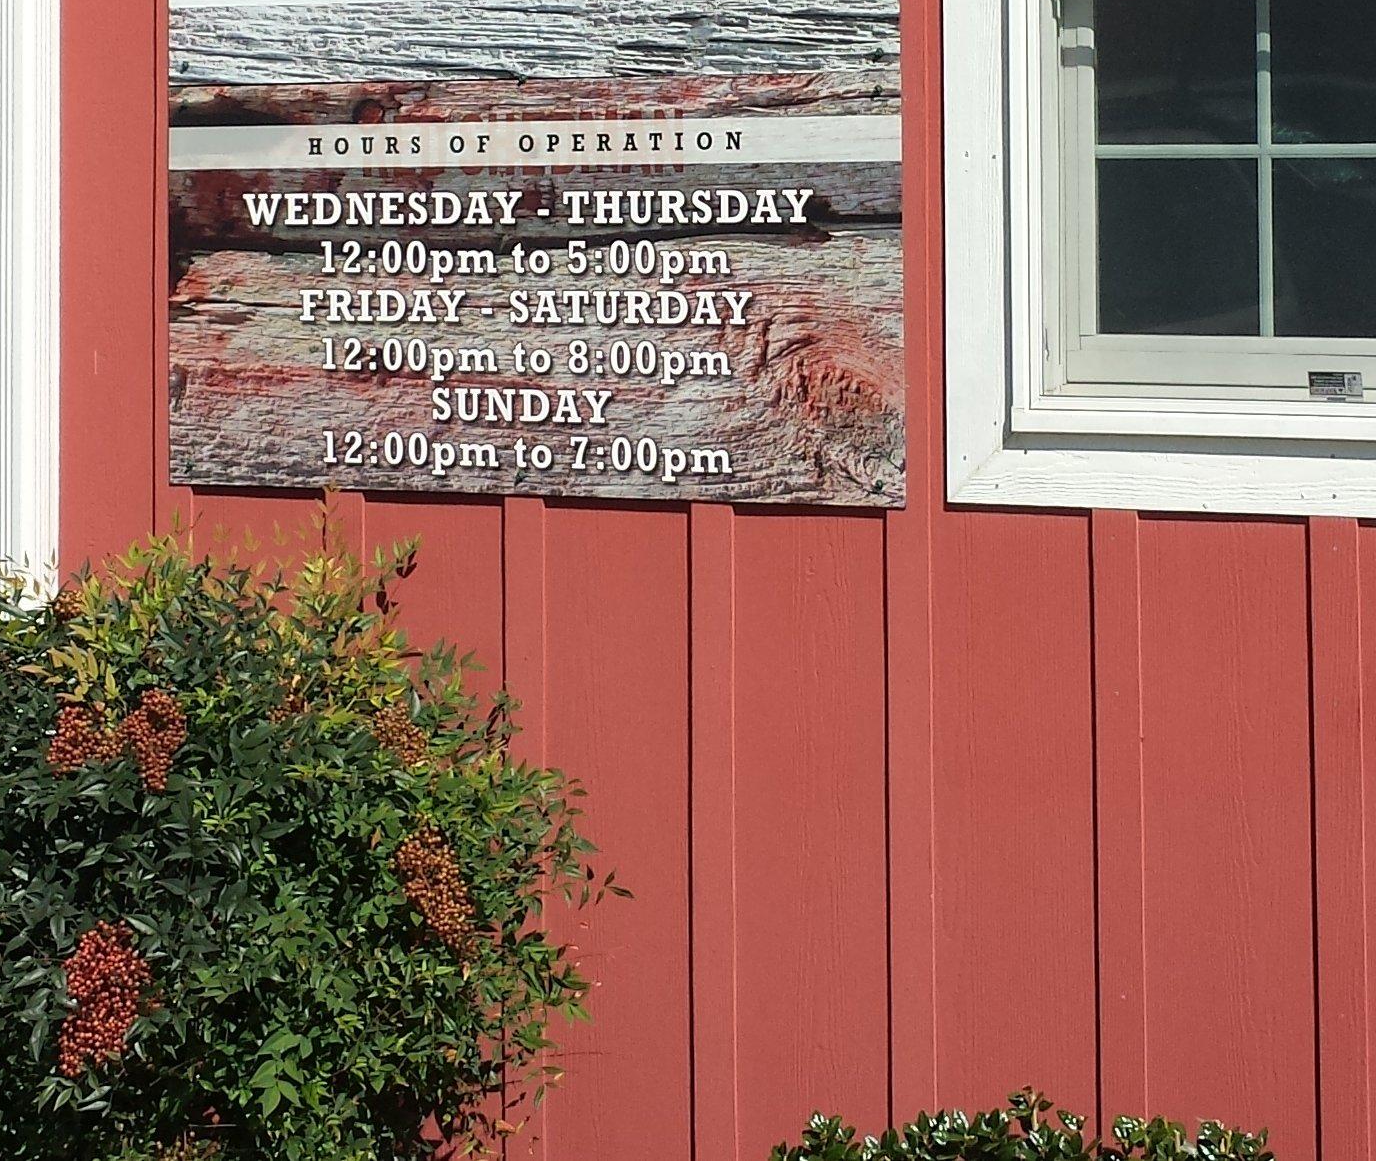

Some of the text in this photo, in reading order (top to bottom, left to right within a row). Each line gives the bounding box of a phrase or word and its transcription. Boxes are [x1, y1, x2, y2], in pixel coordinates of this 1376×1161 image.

[309, 131, 745, 156] HOURS OF OPERATION
[243, 188, 814, 226] WEDNESDAY - THURSDAY
[320, 241, 731, 283] 12:00pm to 5:00pm
[299, 289, 753, 326] FRIDAY - SATURDAY
[321, 338, 732, 384] 12:00pm to 8:00pm
[431, 388, 612, 424] SUNDAY
[322, 431, 733, 482] 12:00pm to 7:00pm
